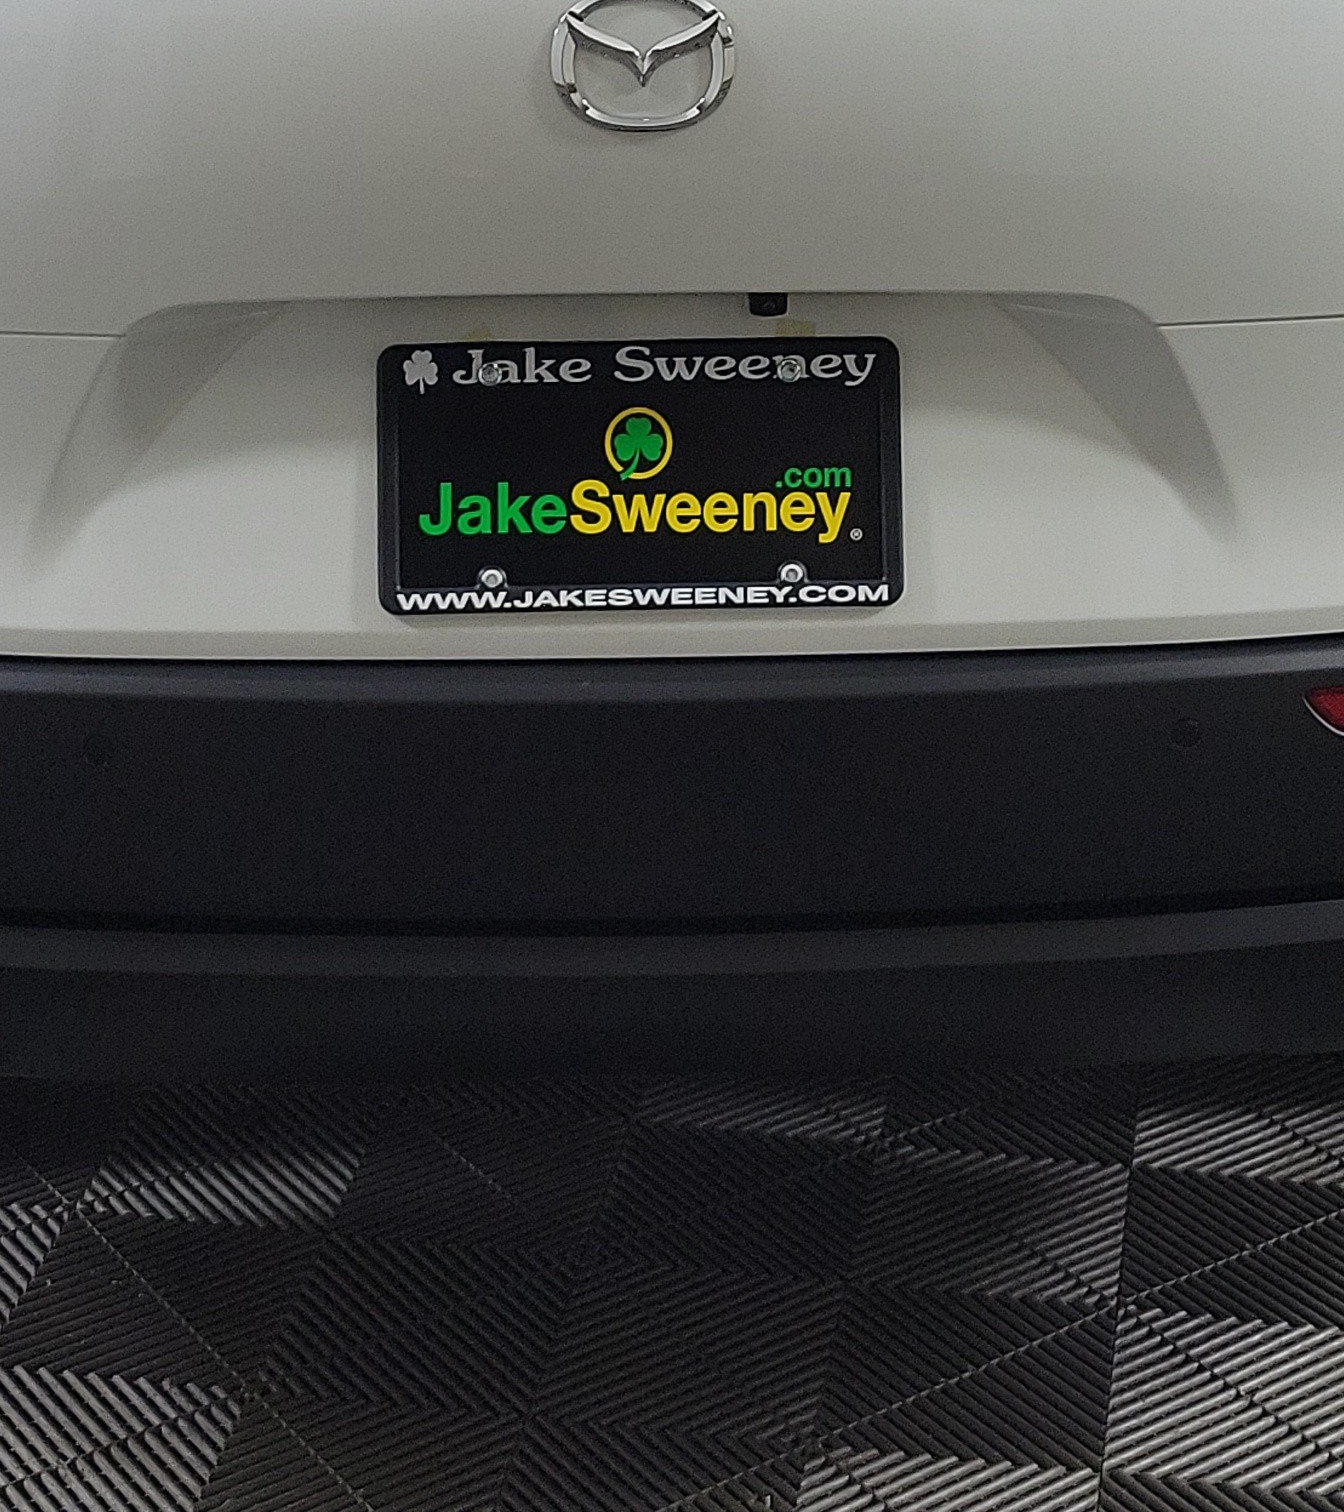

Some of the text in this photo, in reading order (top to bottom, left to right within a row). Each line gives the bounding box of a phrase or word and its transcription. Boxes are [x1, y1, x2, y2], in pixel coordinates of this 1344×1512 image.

[453, 345, 877, 387] Jake Sweeney
[396, 583, 890, 612] WWW.JAKESWEENEY.COM
